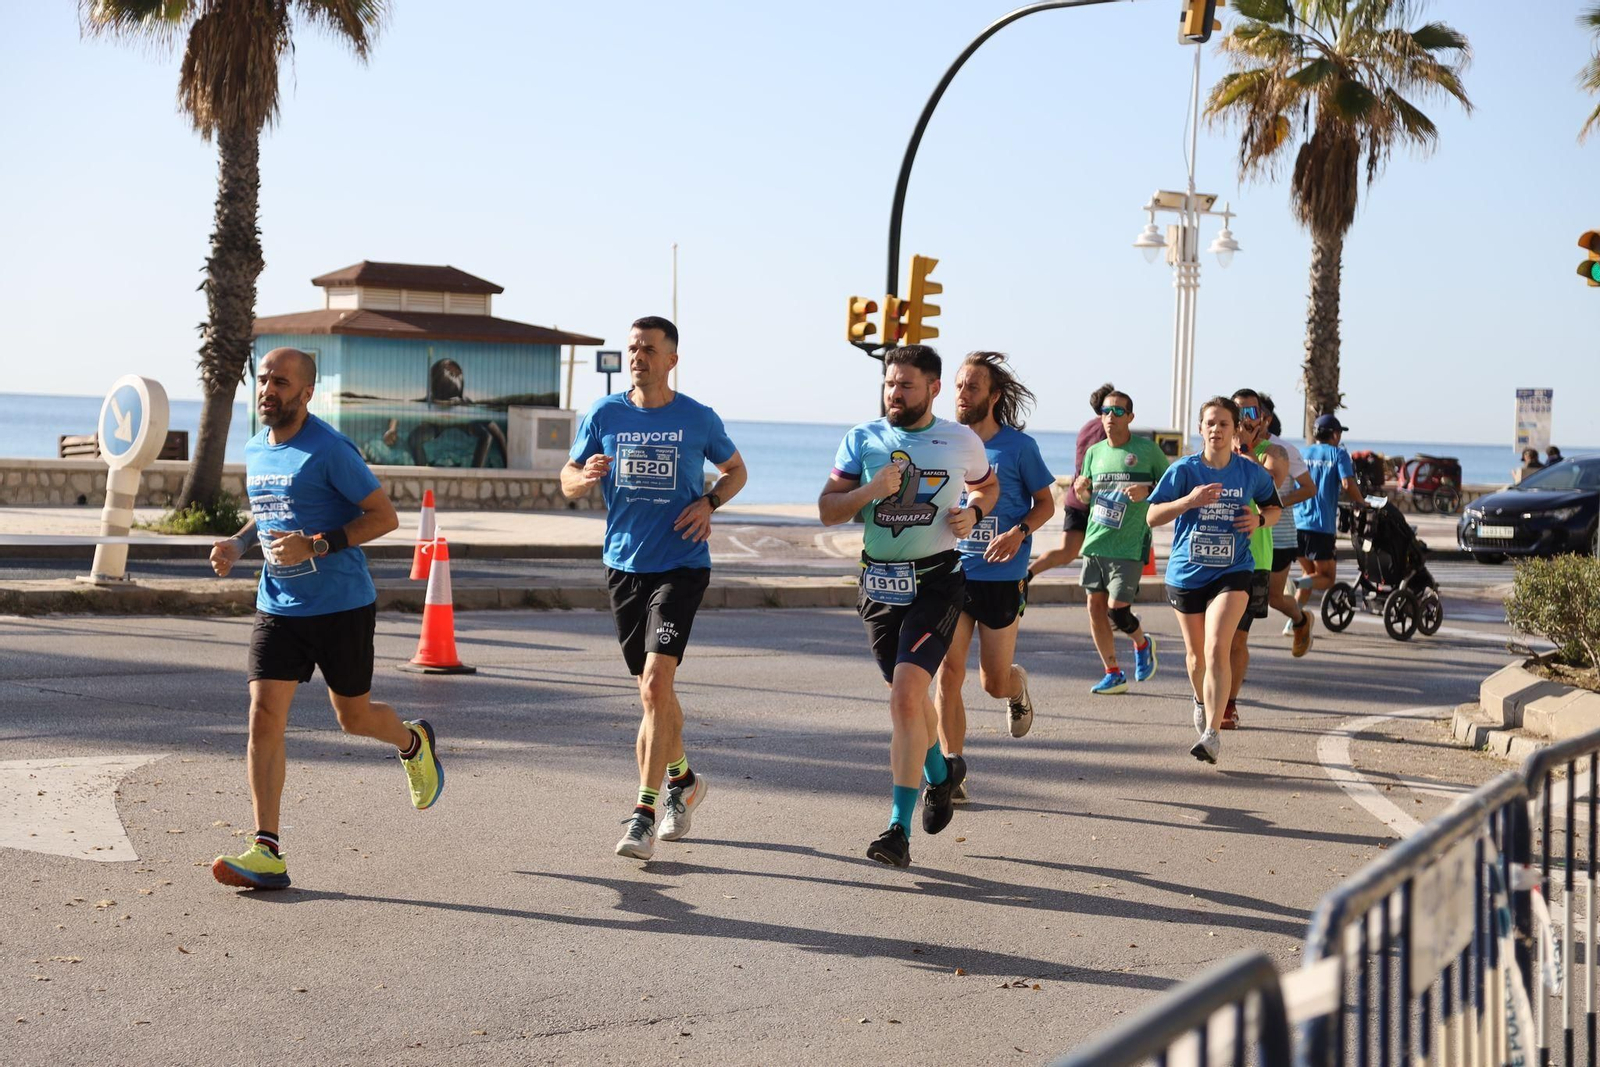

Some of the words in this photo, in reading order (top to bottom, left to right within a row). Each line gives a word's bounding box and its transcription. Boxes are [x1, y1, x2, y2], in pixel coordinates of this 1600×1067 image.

[616, 429, 683, 444] mayoral
[625, 461, 669, 475] 1520
[1097, 473, 1130, 481] ATLETISMO
[1095, 506, 1120, 519] 1852
[971, 530, 991, 541] 46
[1195, 545, 1229, 556] 2124
[869, 576, 909, 591] 1910
